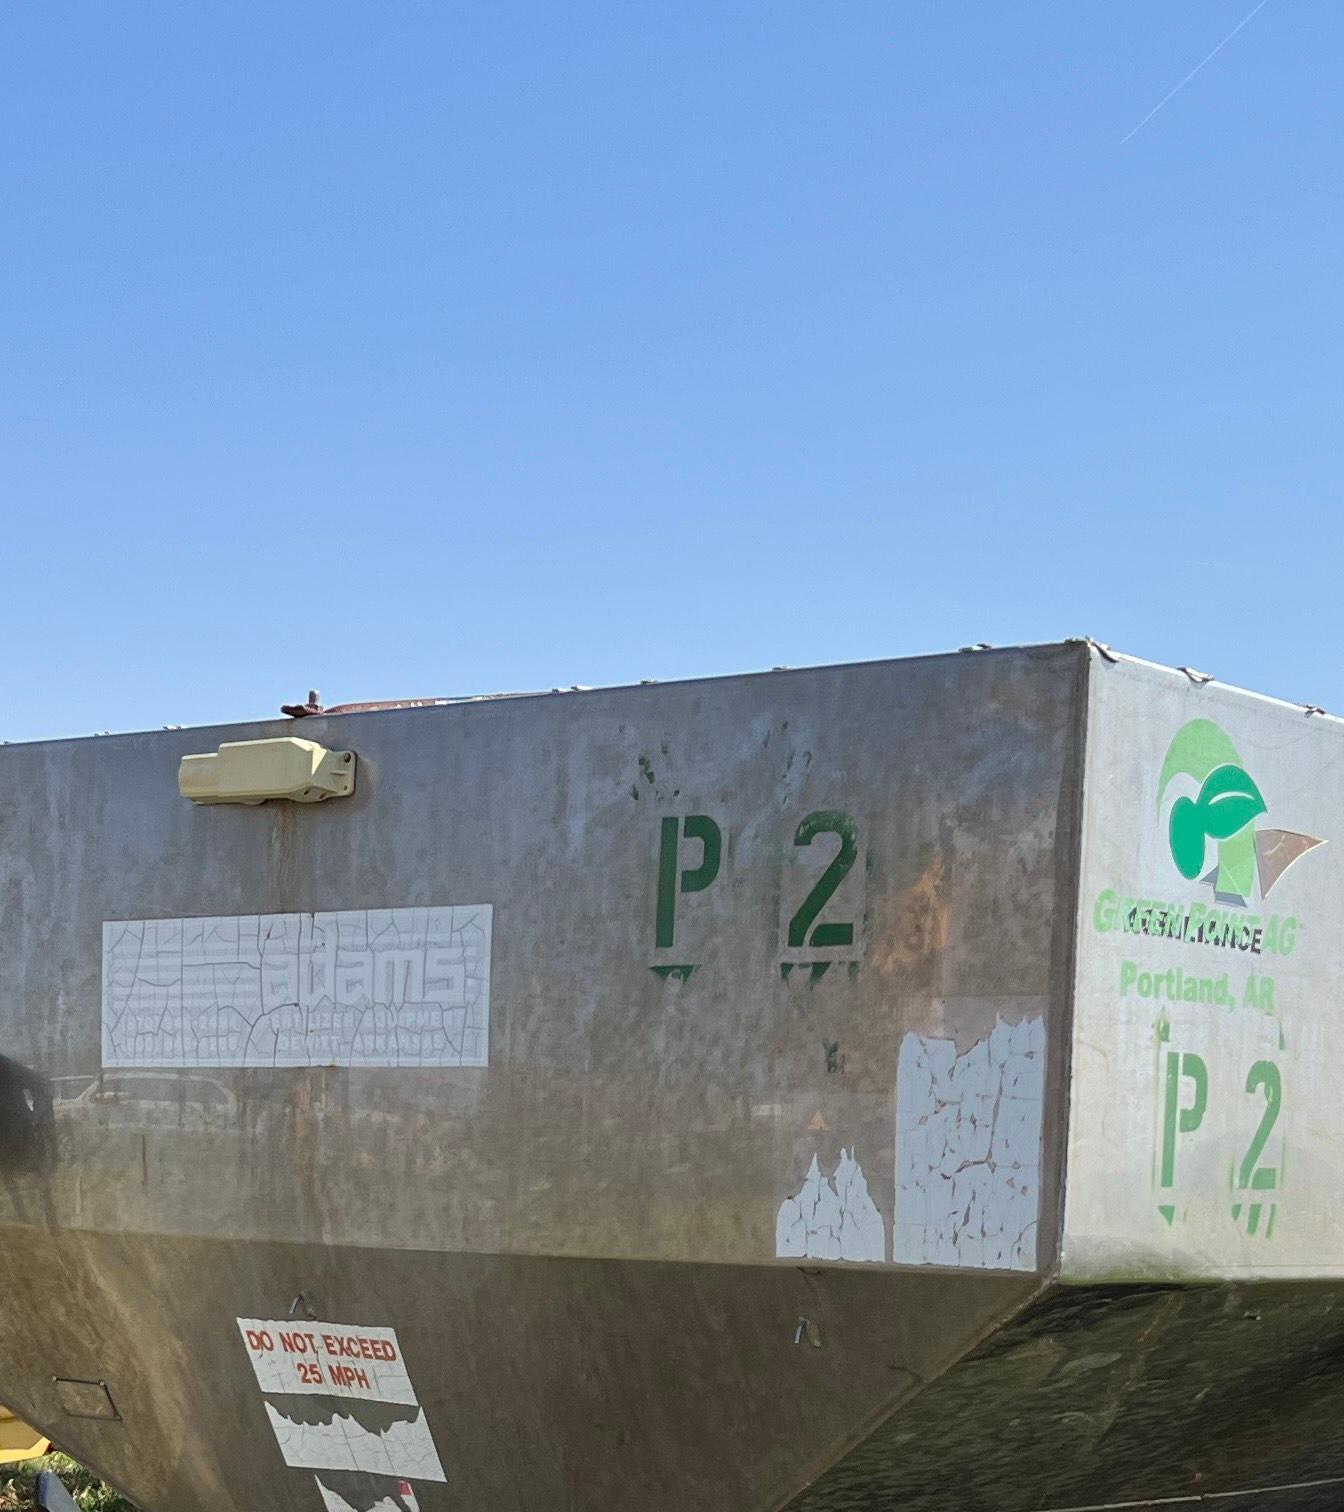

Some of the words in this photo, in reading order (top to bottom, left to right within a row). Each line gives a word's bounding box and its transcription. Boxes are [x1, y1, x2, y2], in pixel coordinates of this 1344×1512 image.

[656, 815, 722, 948] P
[787, 810, 857, 948] 2
[1262, 912, 1299, 956] AG
[1120, 959, 1236, 1014] Portland,
[1242, 970, 1277, 1016] AR
[1160, 1051, 1207, 1188] P
[1238, 1060, 1282, 1190] 2
[246, 1330, 274, 1351] DO
[279, 1331, 318, 1354] NOT
[320, 1334, 397, 1361] EXCEED
[297, 1362, 323, 1385] 25
[328, 1363, 371, 1390] MPH
